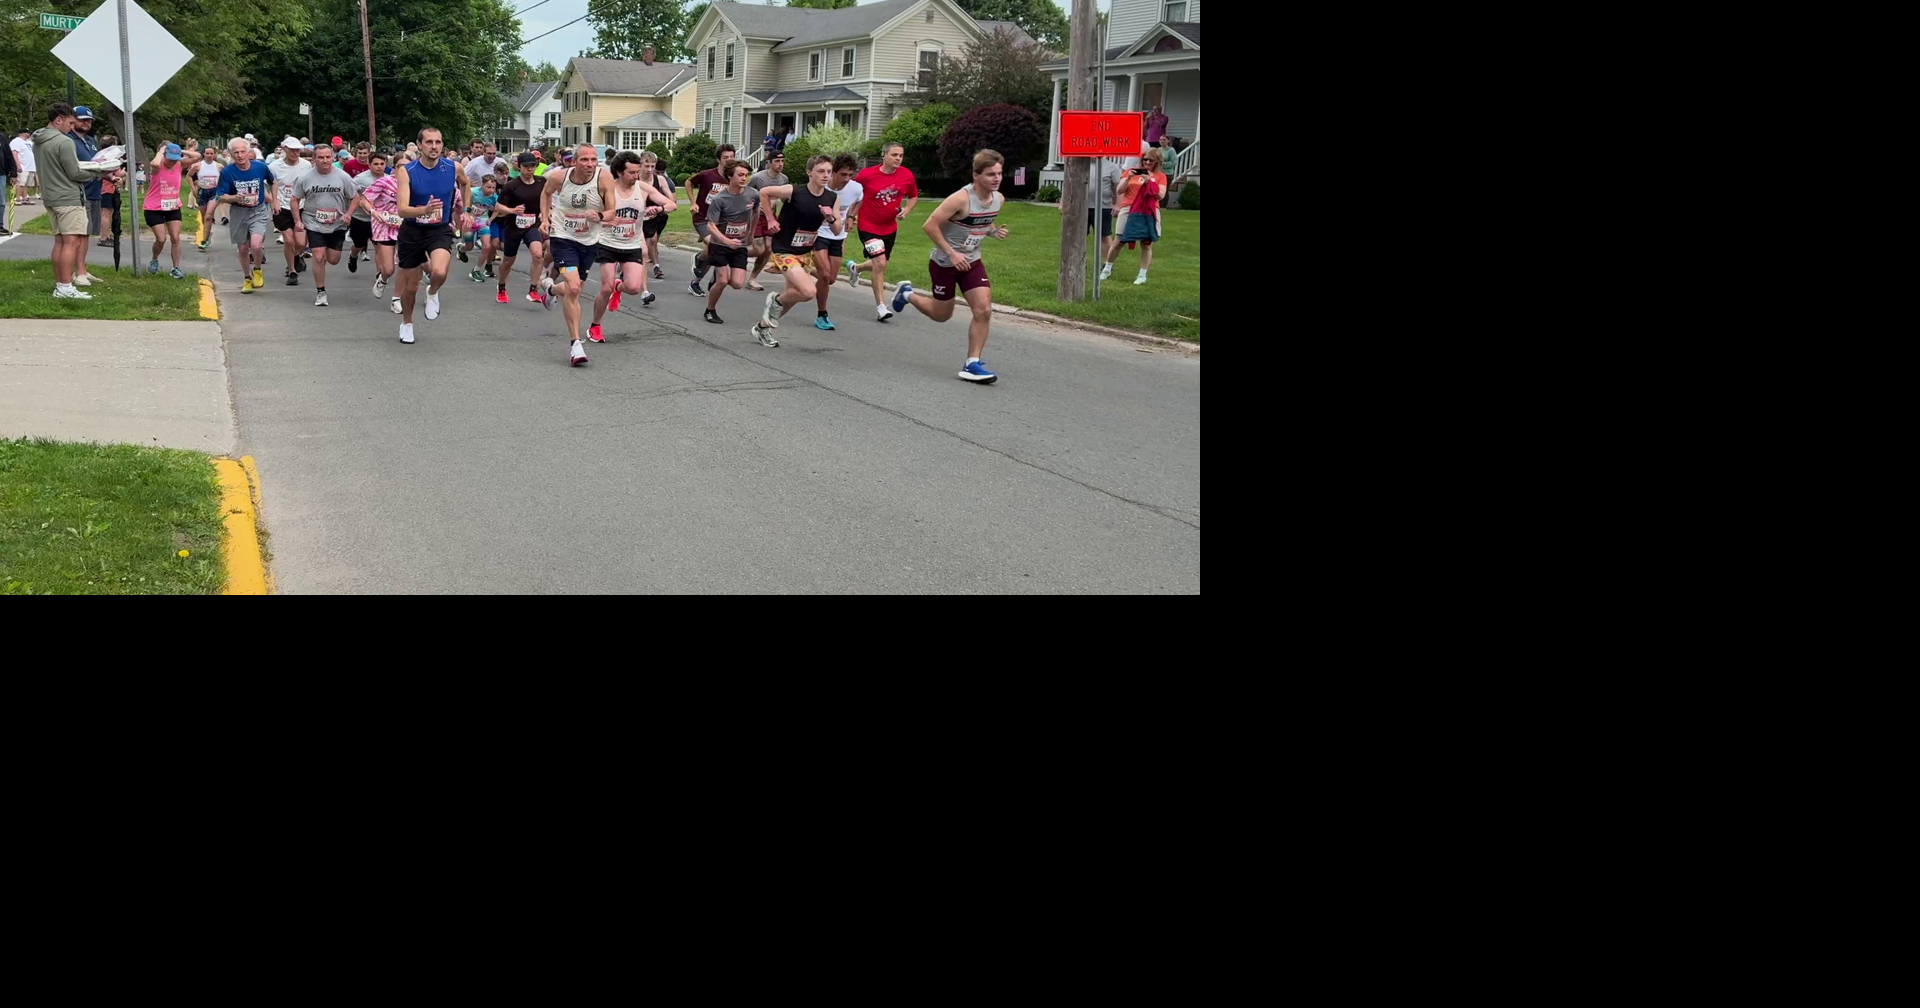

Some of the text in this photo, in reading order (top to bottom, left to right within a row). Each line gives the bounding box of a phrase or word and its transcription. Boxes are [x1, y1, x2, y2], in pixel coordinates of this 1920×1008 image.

[43, 15, 81, 28] MURTY
[1092, 120, 1111, 132] END
[1071, 136, 1130, 148] ROAD WORK
[310, 184, 342, 193] Marines
[317, 212, 328, 220] 320
[565, 220, 577, 228] 287
